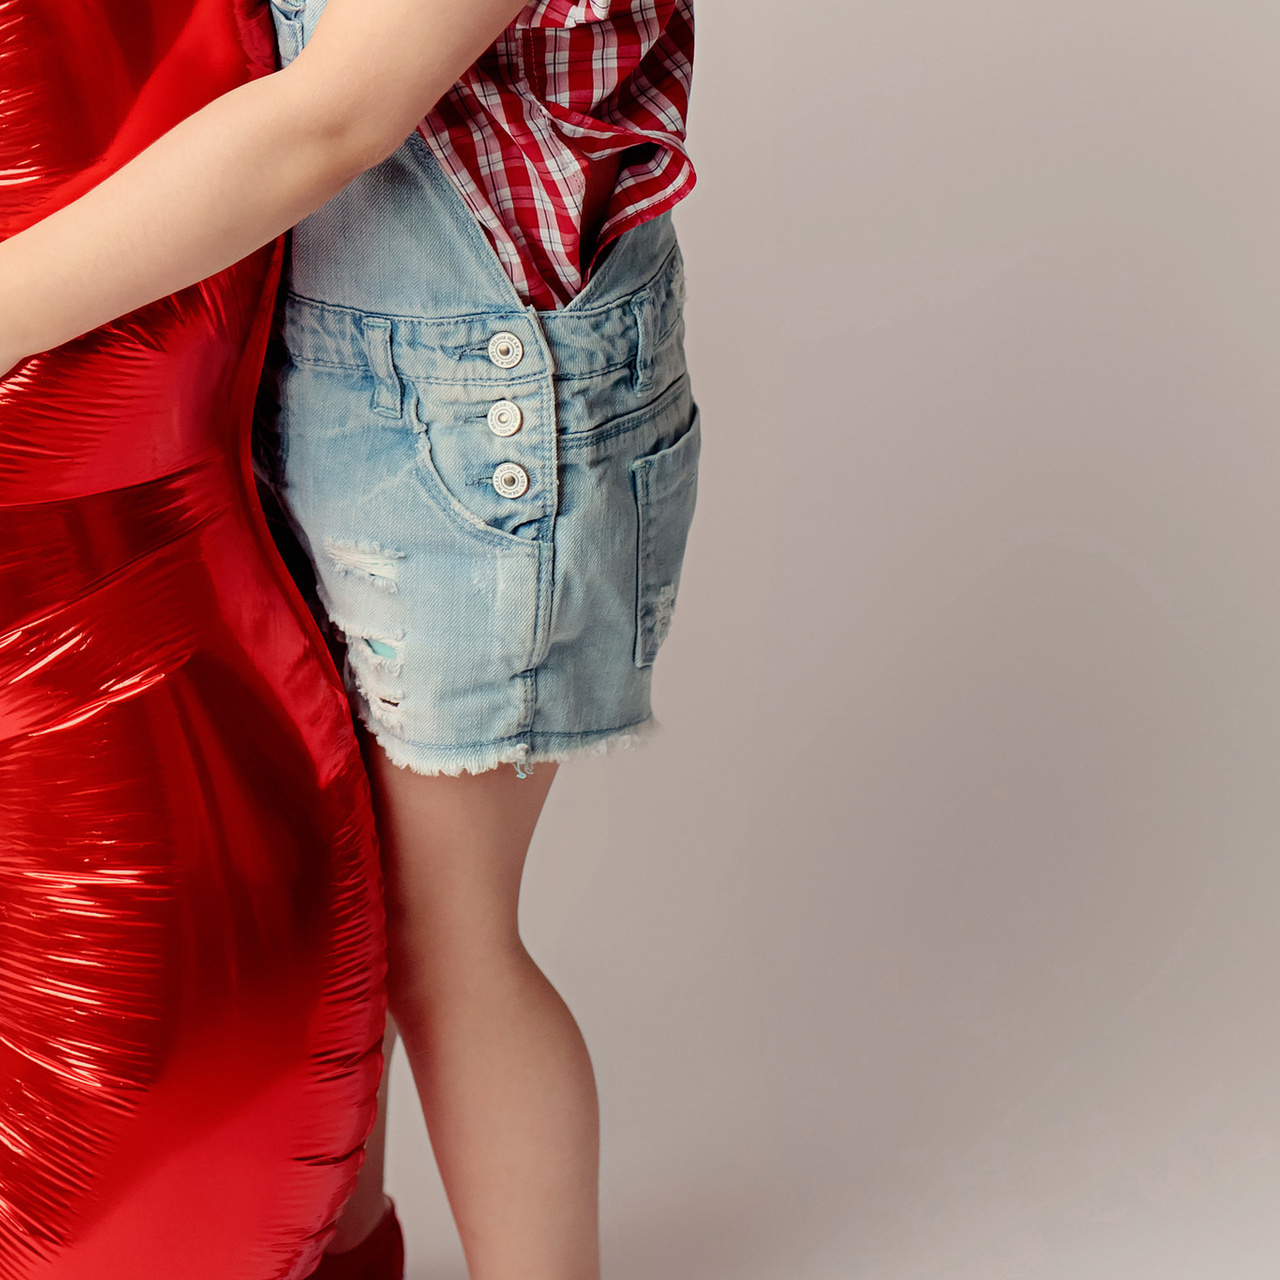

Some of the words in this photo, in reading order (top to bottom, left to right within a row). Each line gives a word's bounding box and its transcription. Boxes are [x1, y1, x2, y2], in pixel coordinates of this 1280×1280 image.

[490, 335, 506, 346] DENIM
[506, 335, 520, 348] WEAR
[499, 466, 522, 474] ACOOLA
